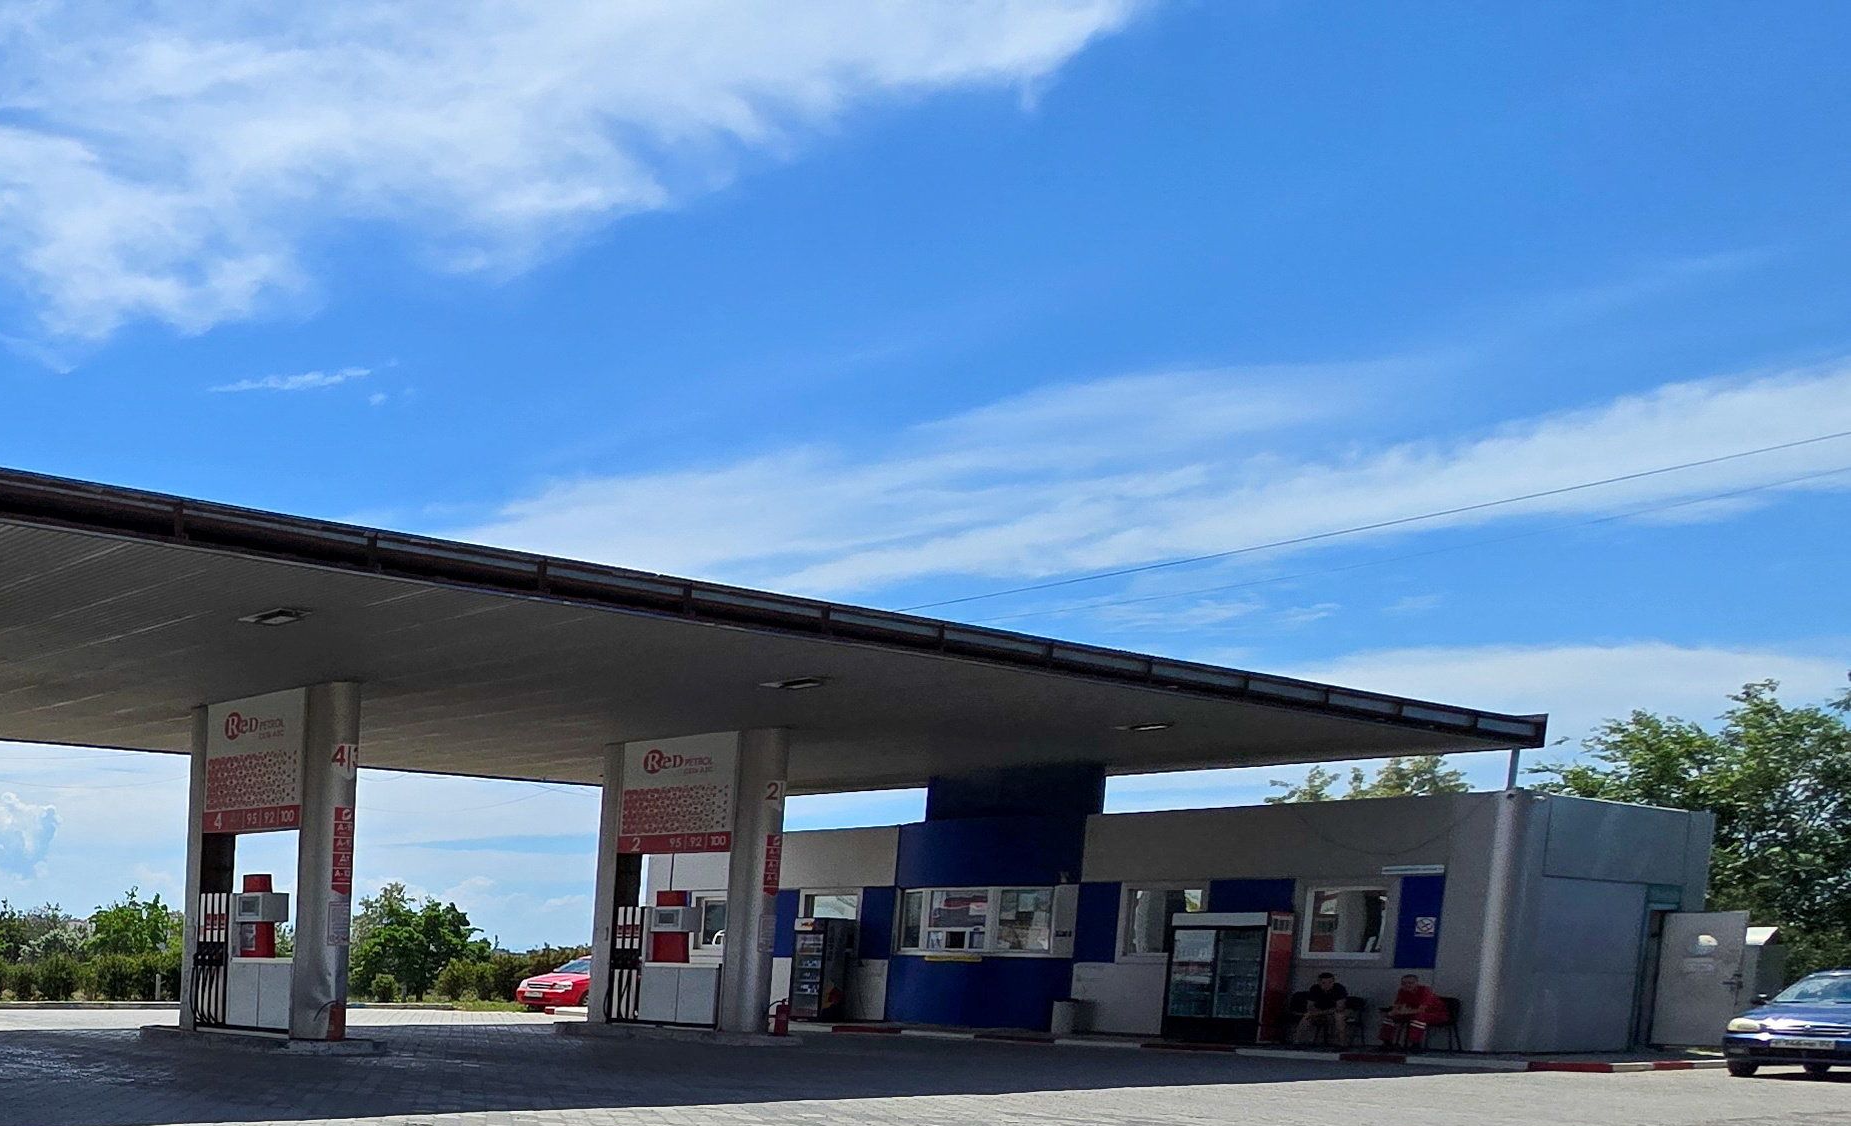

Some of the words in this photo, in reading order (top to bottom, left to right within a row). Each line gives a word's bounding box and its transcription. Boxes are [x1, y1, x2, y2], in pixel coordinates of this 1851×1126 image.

[331, 745, 346, 767] 4
[766, 782, 779, 800] 2
[213, 812, 223, 830] 4
[246, 812, 258, 826] 95
[264, 811, 275, 824] 92
[281, 809, 295, 823] 100
[630, 837, 641, 852] 2
[670, 838, 682, 848] 95
[690, 836, 702, 847] 92
[710, 835, 726, 846] 100
